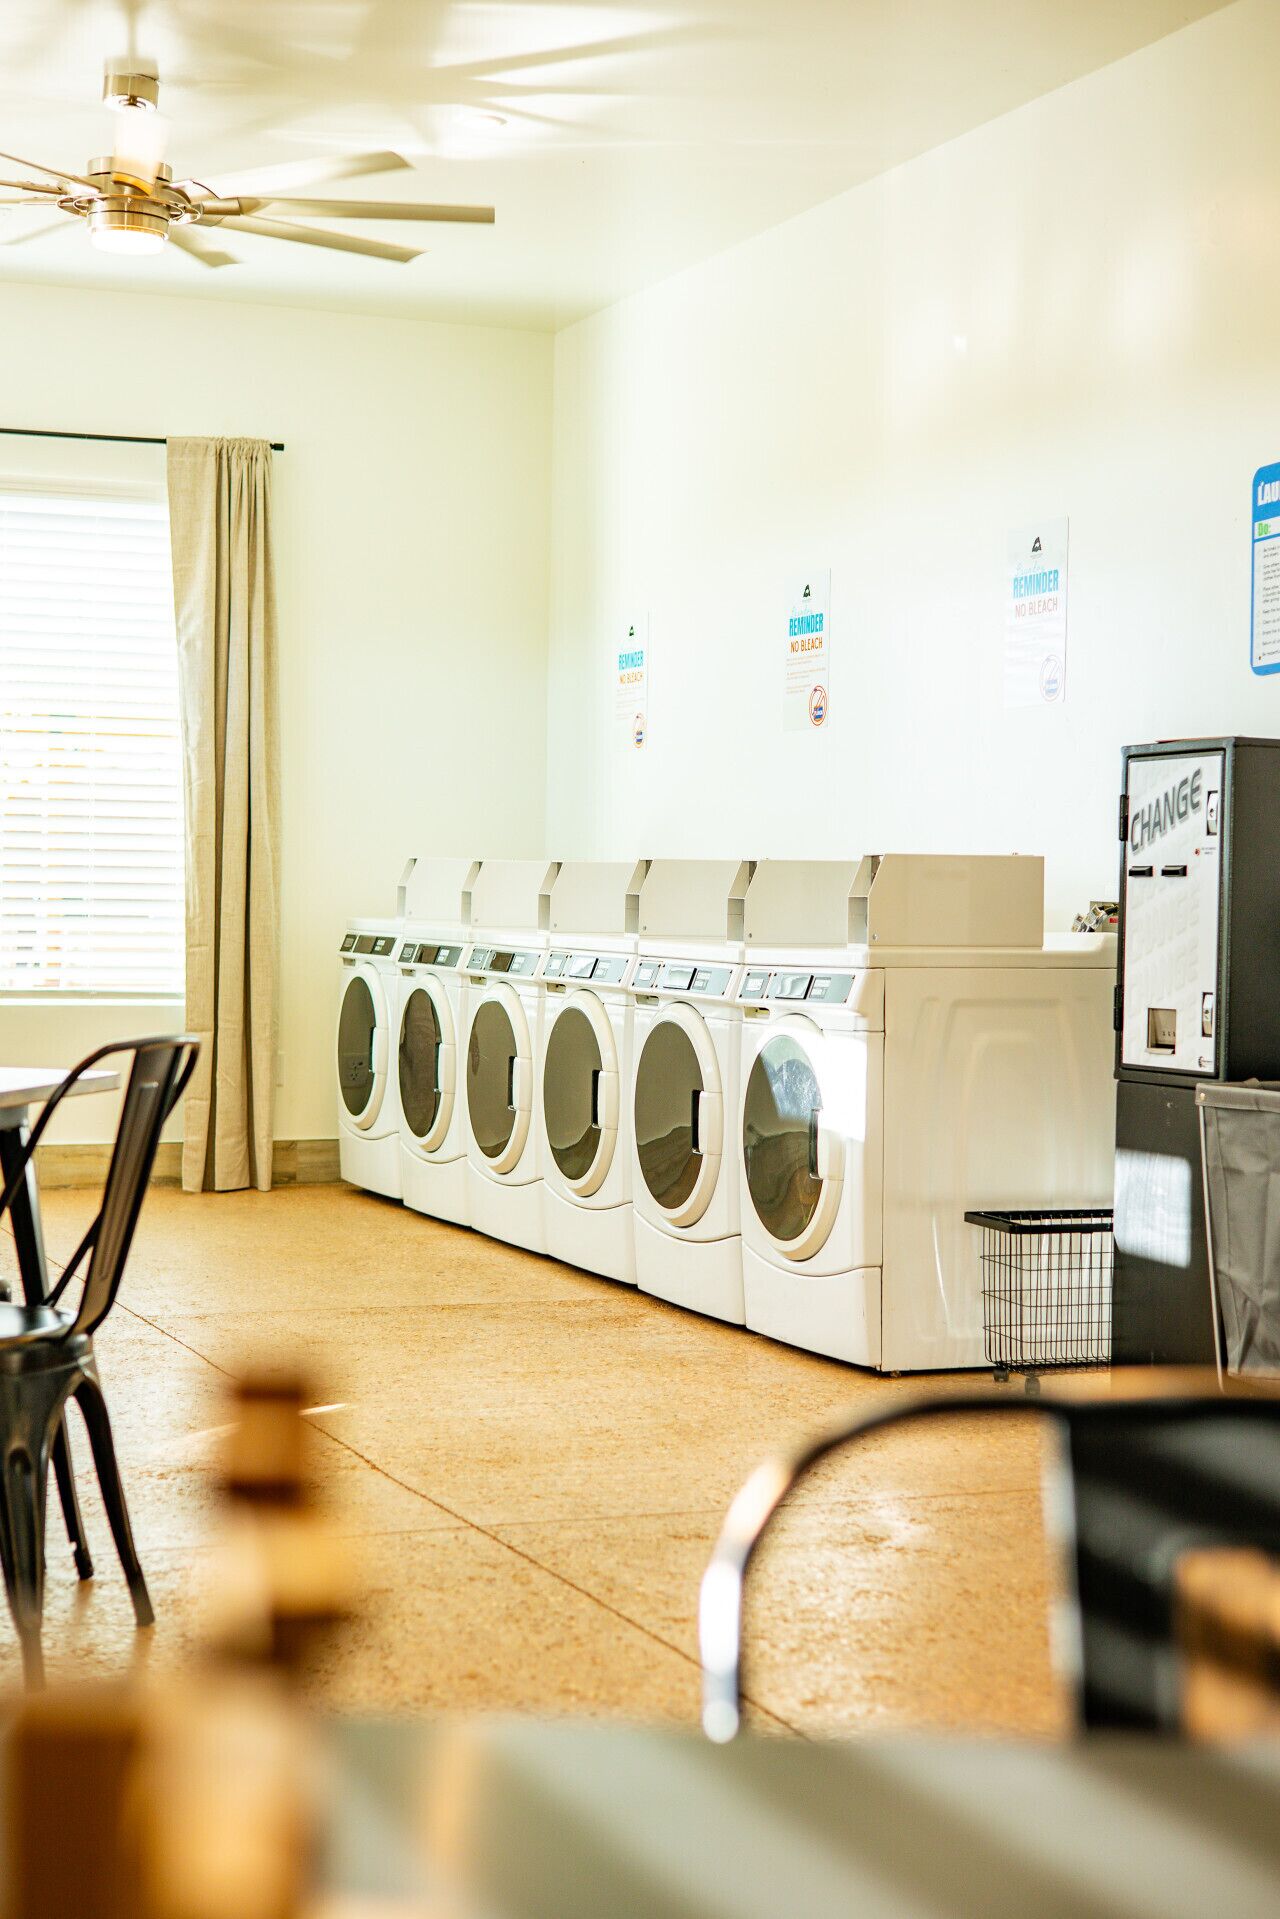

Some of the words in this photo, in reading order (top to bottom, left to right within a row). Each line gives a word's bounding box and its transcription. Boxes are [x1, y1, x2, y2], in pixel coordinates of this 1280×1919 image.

[1257, 481, 1280, 506] LAU
[1258, 522, 1271, 536] Do:
[1013, 569, 1059, 598] REMINDER
[1015, 603, 1026, 617] NO
[1028, 597, 1058, 615] BLEACH
[789, 613, 823, 636] REMINDER
[790, 640, 799, 653] NO
[801, 637, 823, 652] BLEACH
[619, 650, 643, 670] REMINDER
[1130, 767, 1201, 854] CHANGE
